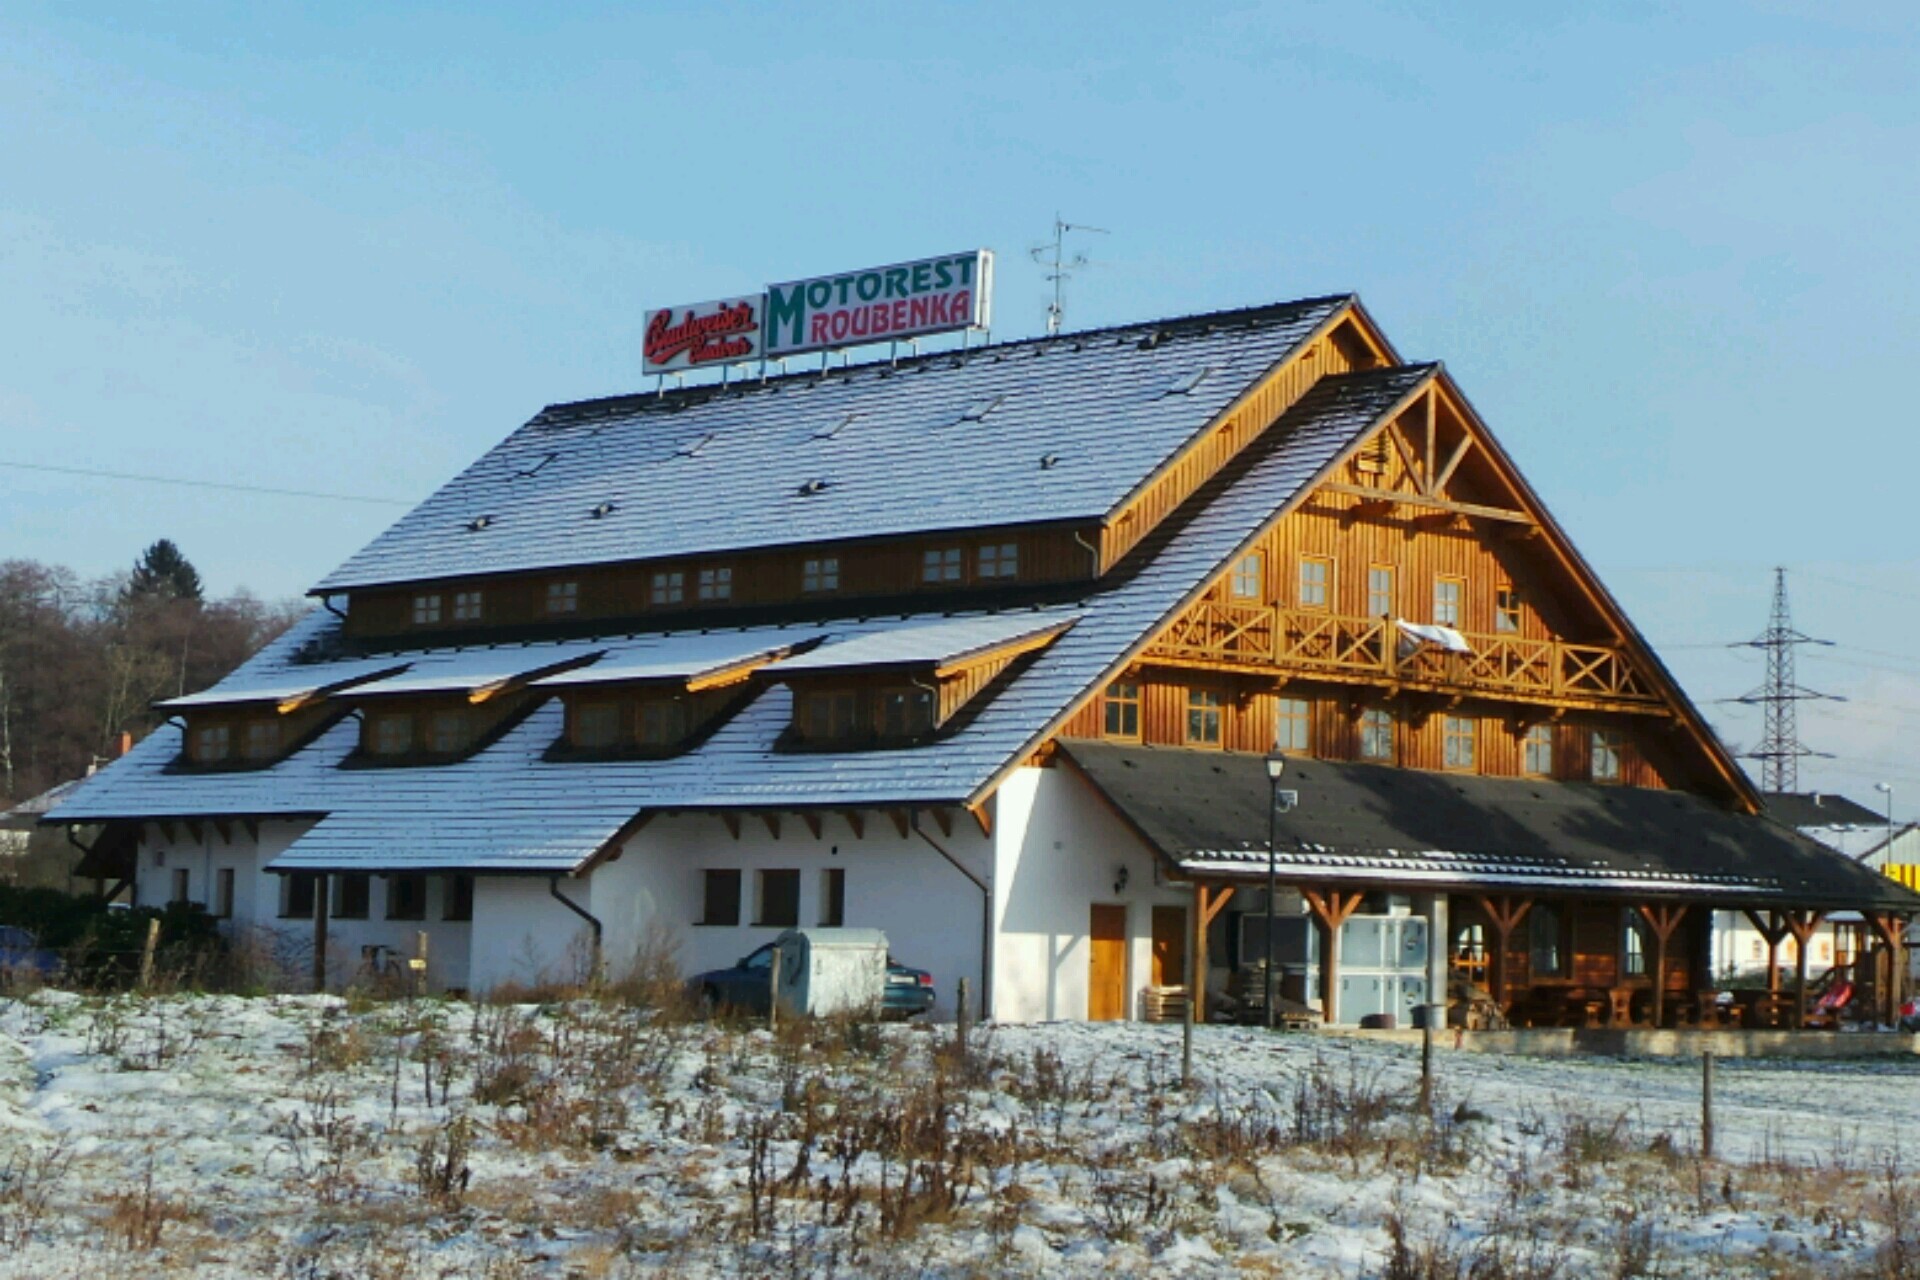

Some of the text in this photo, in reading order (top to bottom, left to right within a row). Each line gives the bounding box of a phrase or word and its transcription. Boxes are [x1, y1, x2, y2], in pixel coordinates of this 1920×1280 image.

[645, 300, 758, 364] Budweiser
[768, 256, 977, 347] MOTOREST
[811, 290, 970, 343] ROUBENKA
